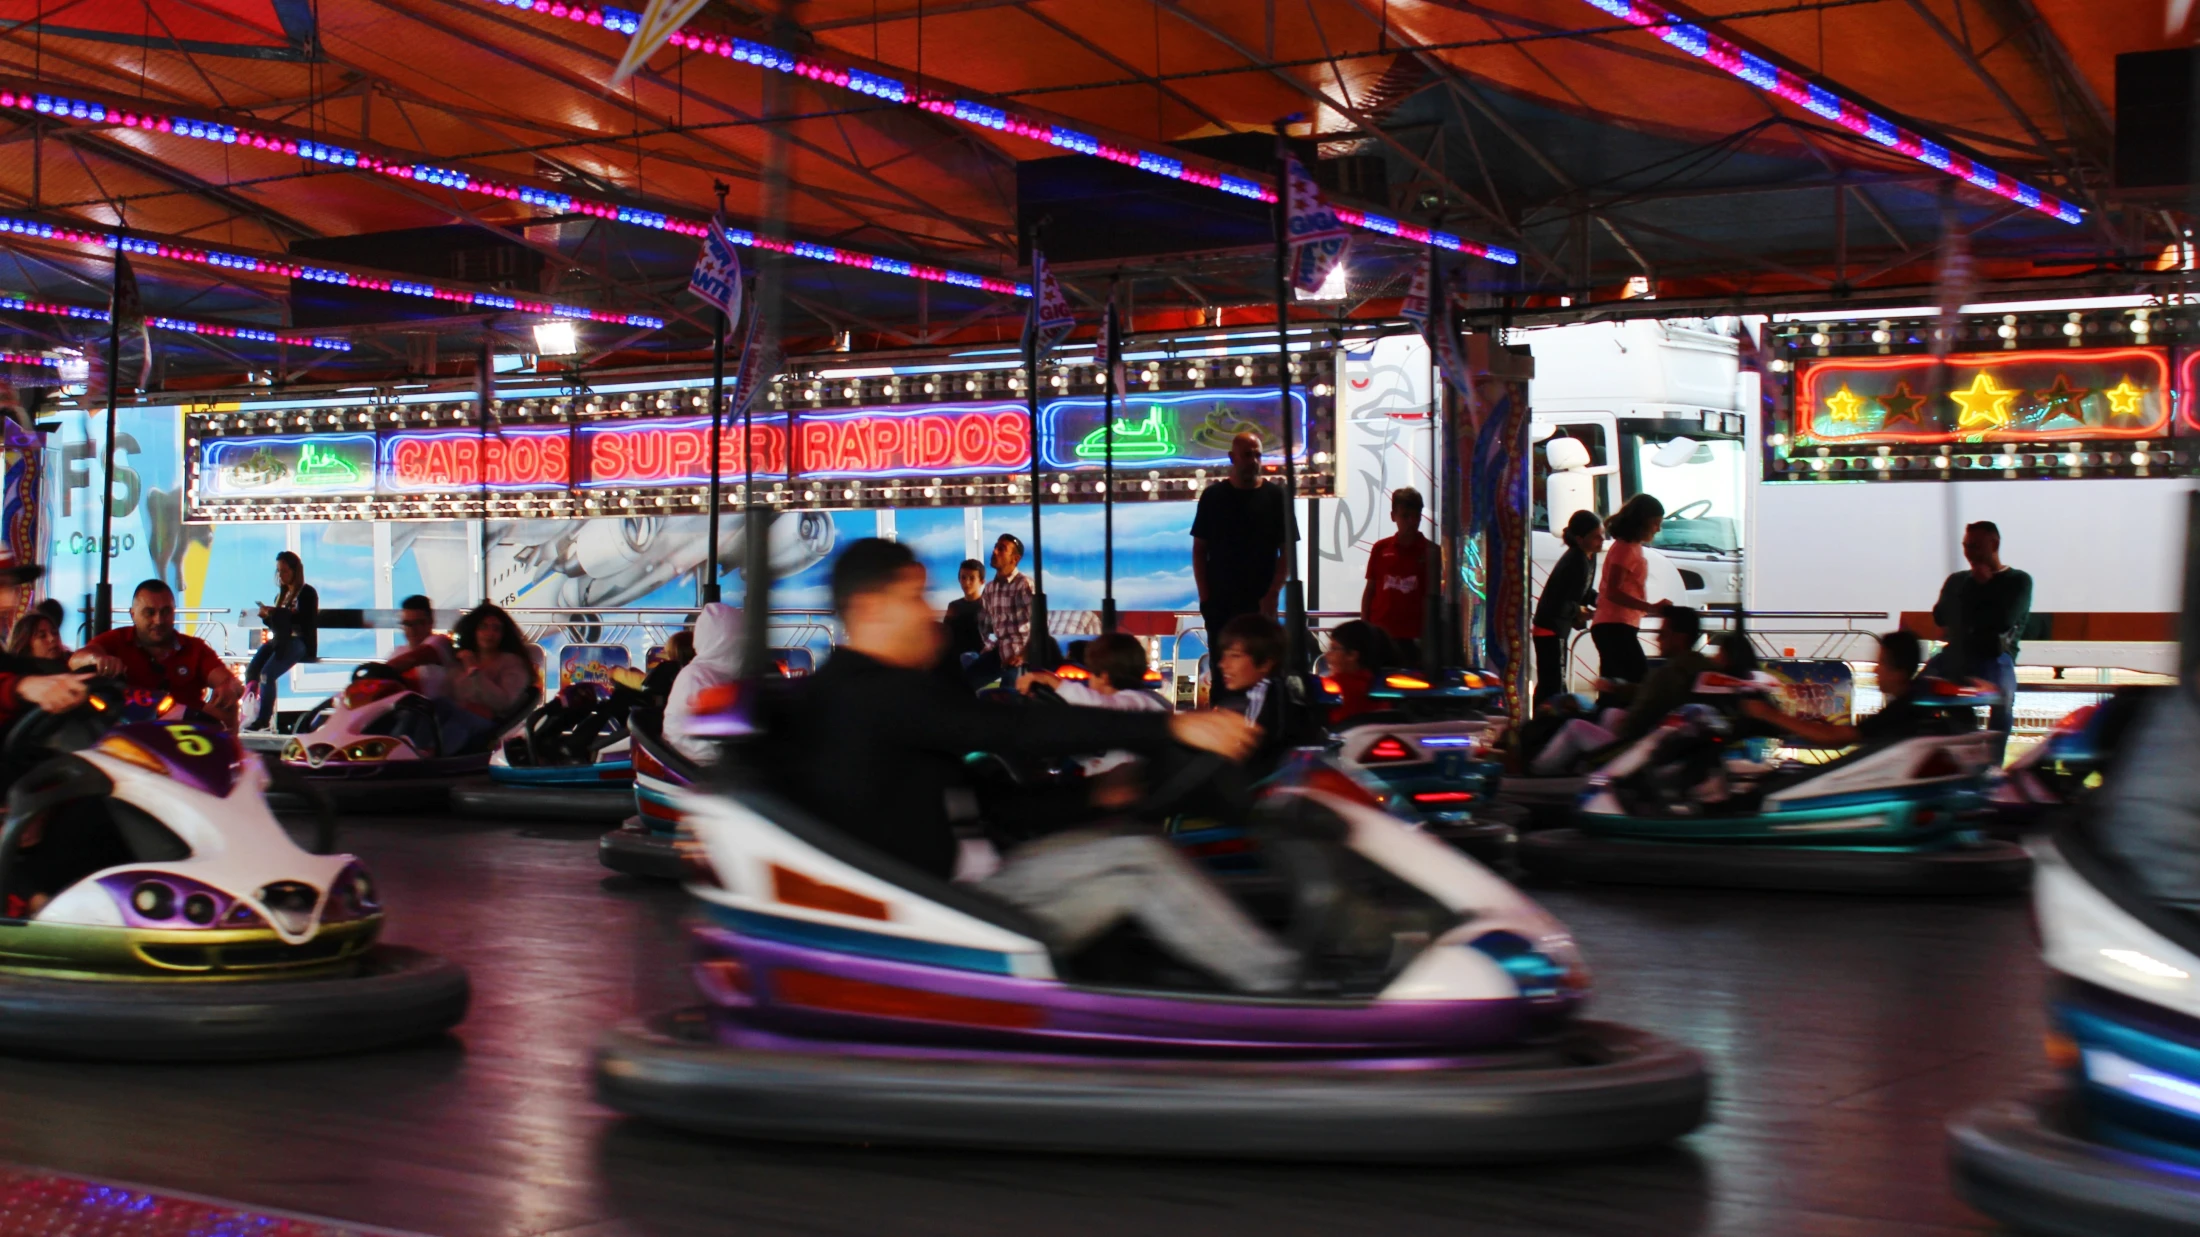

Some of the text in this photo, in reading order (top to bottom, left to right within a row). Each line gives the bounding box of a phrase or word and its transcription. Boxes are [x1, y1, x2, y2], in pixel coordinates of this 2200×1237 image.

[398, 435, 569, 483] CARROS
[591, 424, 786, 479] SUPER
[500, 592, 516, 608] TFS
[164, 724, 213, 756] 5
